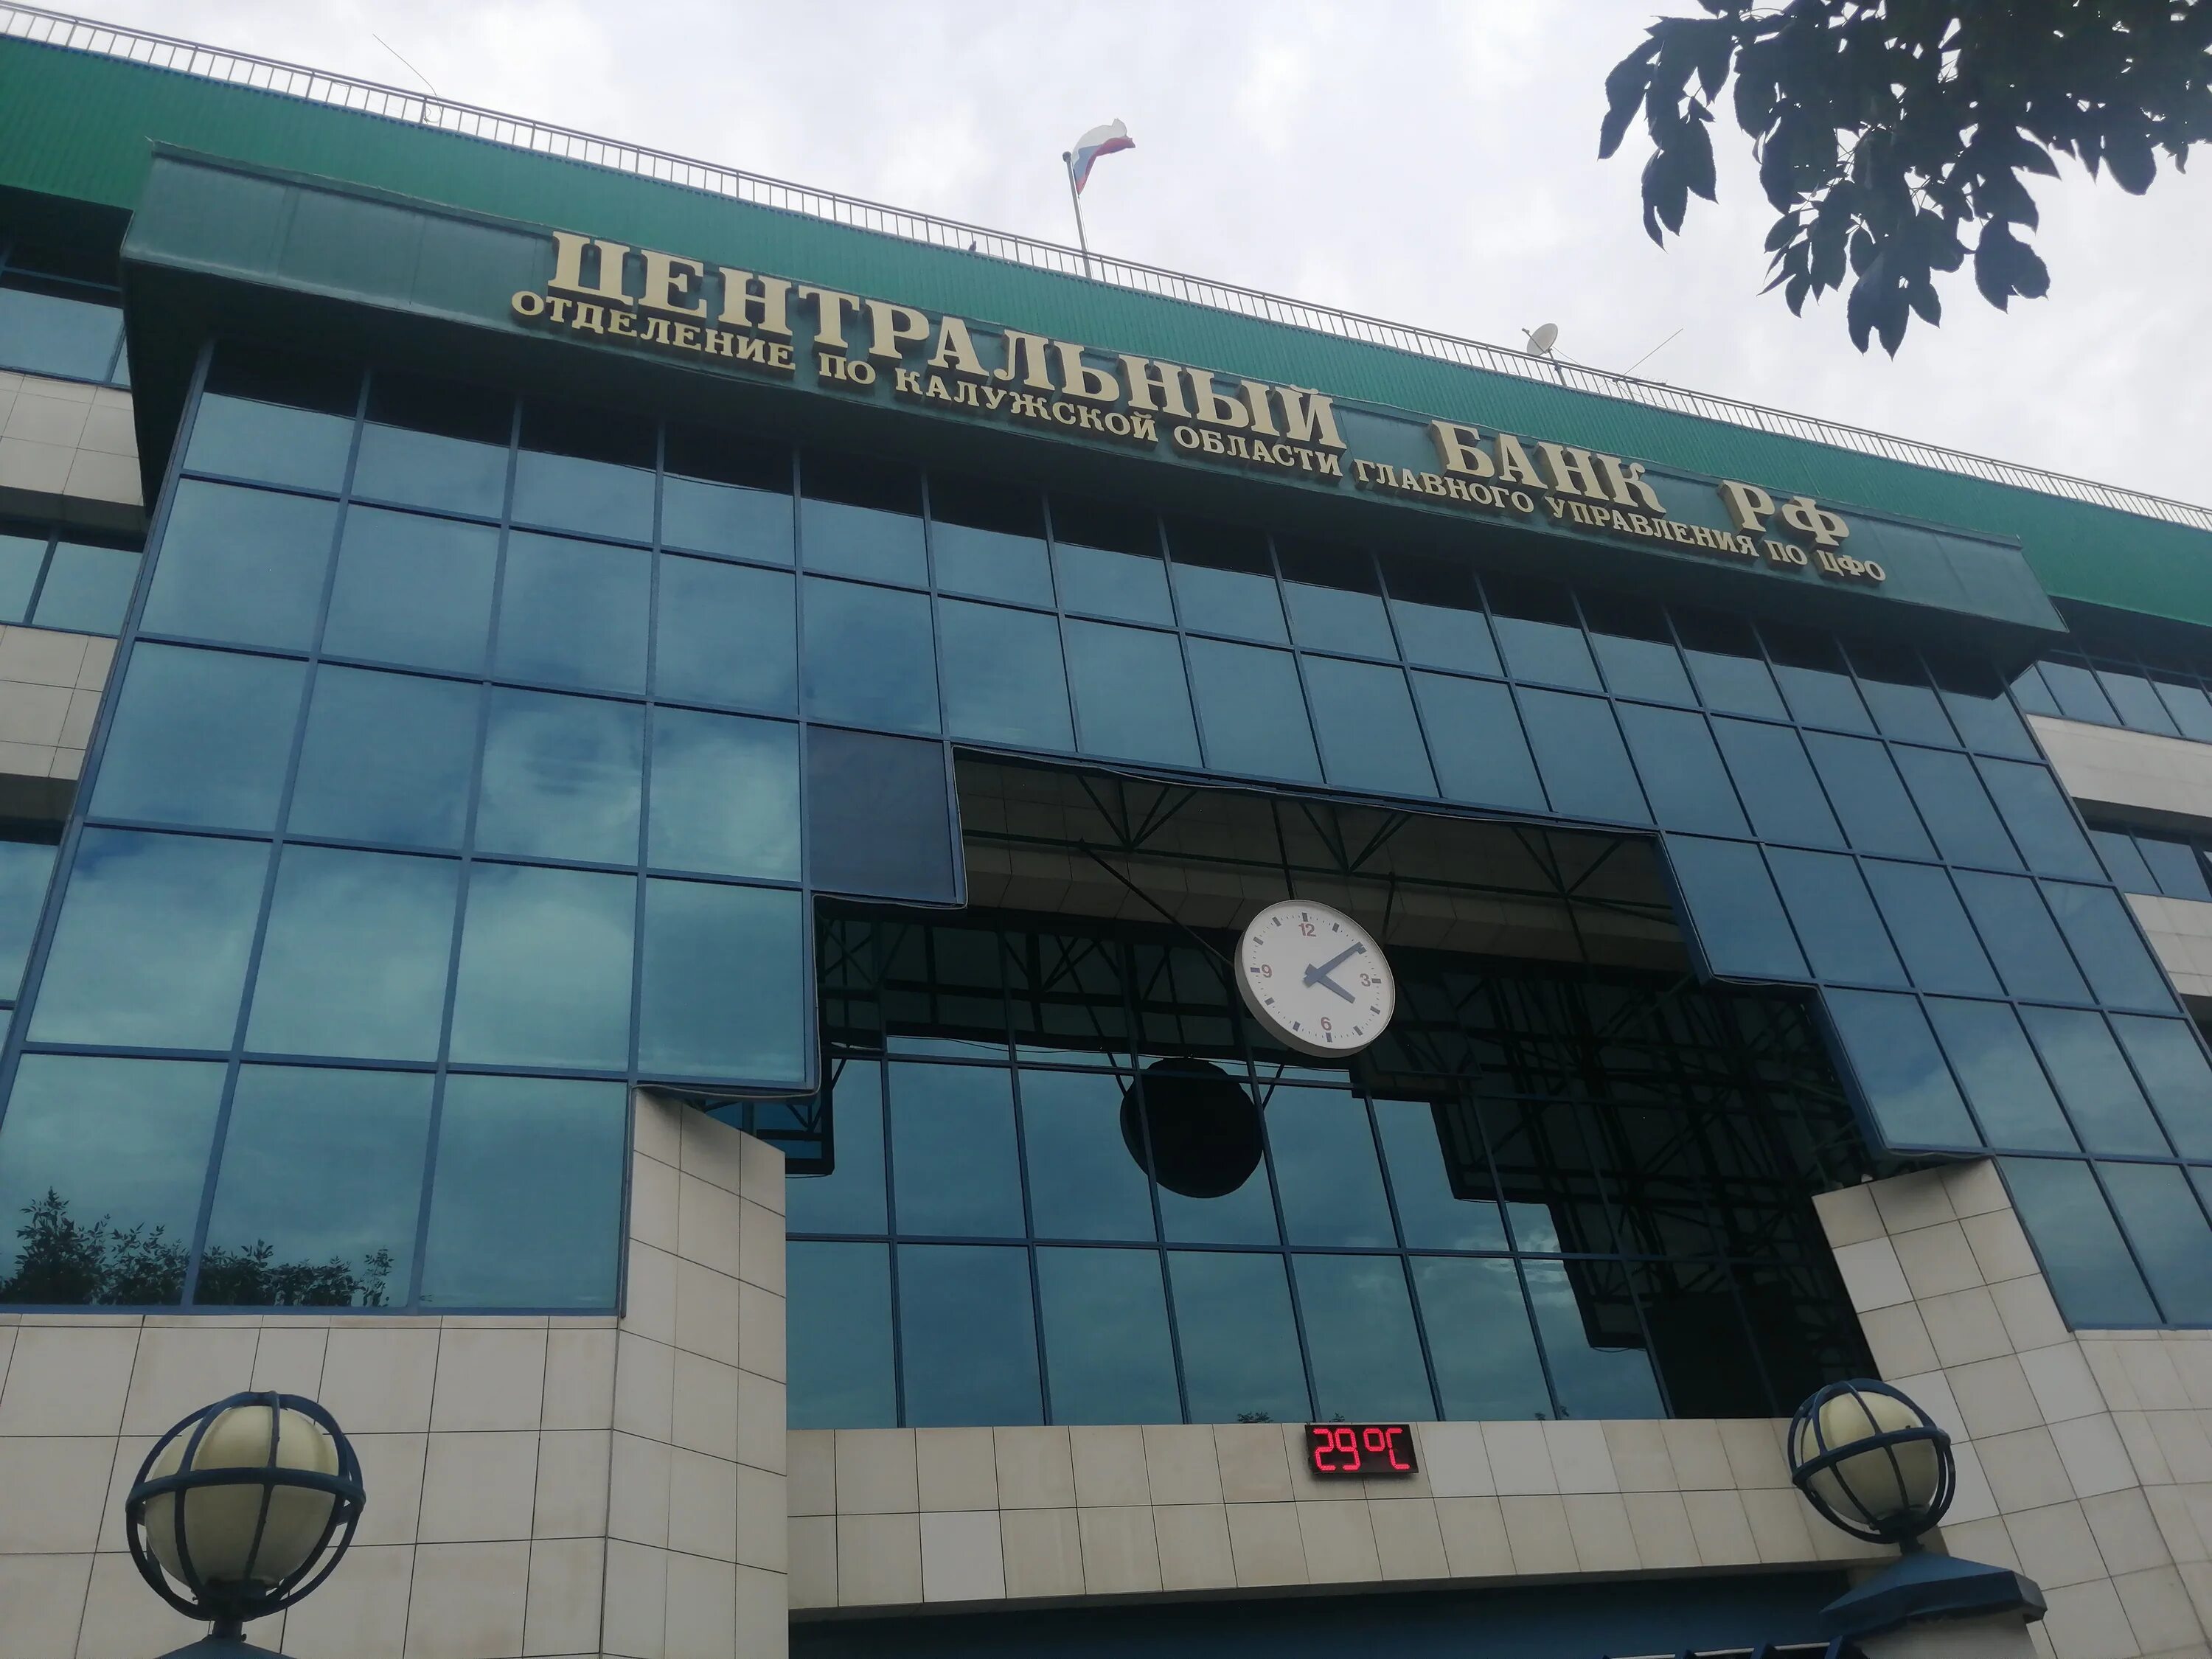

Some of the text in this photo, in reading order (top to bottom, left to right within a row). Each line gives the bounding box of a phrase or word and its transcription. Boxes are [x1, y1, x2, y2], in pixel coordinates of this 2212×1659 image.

[548, 231, 1849, 546] ЦЕНТРАЛЬНЫЙ БАНК РФ
[511, 291, 1886, 582] ОТДЕЛЕНИЕ ПО КАЛУЖСКОЙ ОБЛАСТИ ГЛАВНОГО УПРАВЛЕНИЯ ПО ЦФО
[1298, 922, 1316, 937] 12
[1261, 964, 1273, 978] 9
[1360, 973, 1371, 987] 3
[1321, 1017, 1332, 1031] 6
